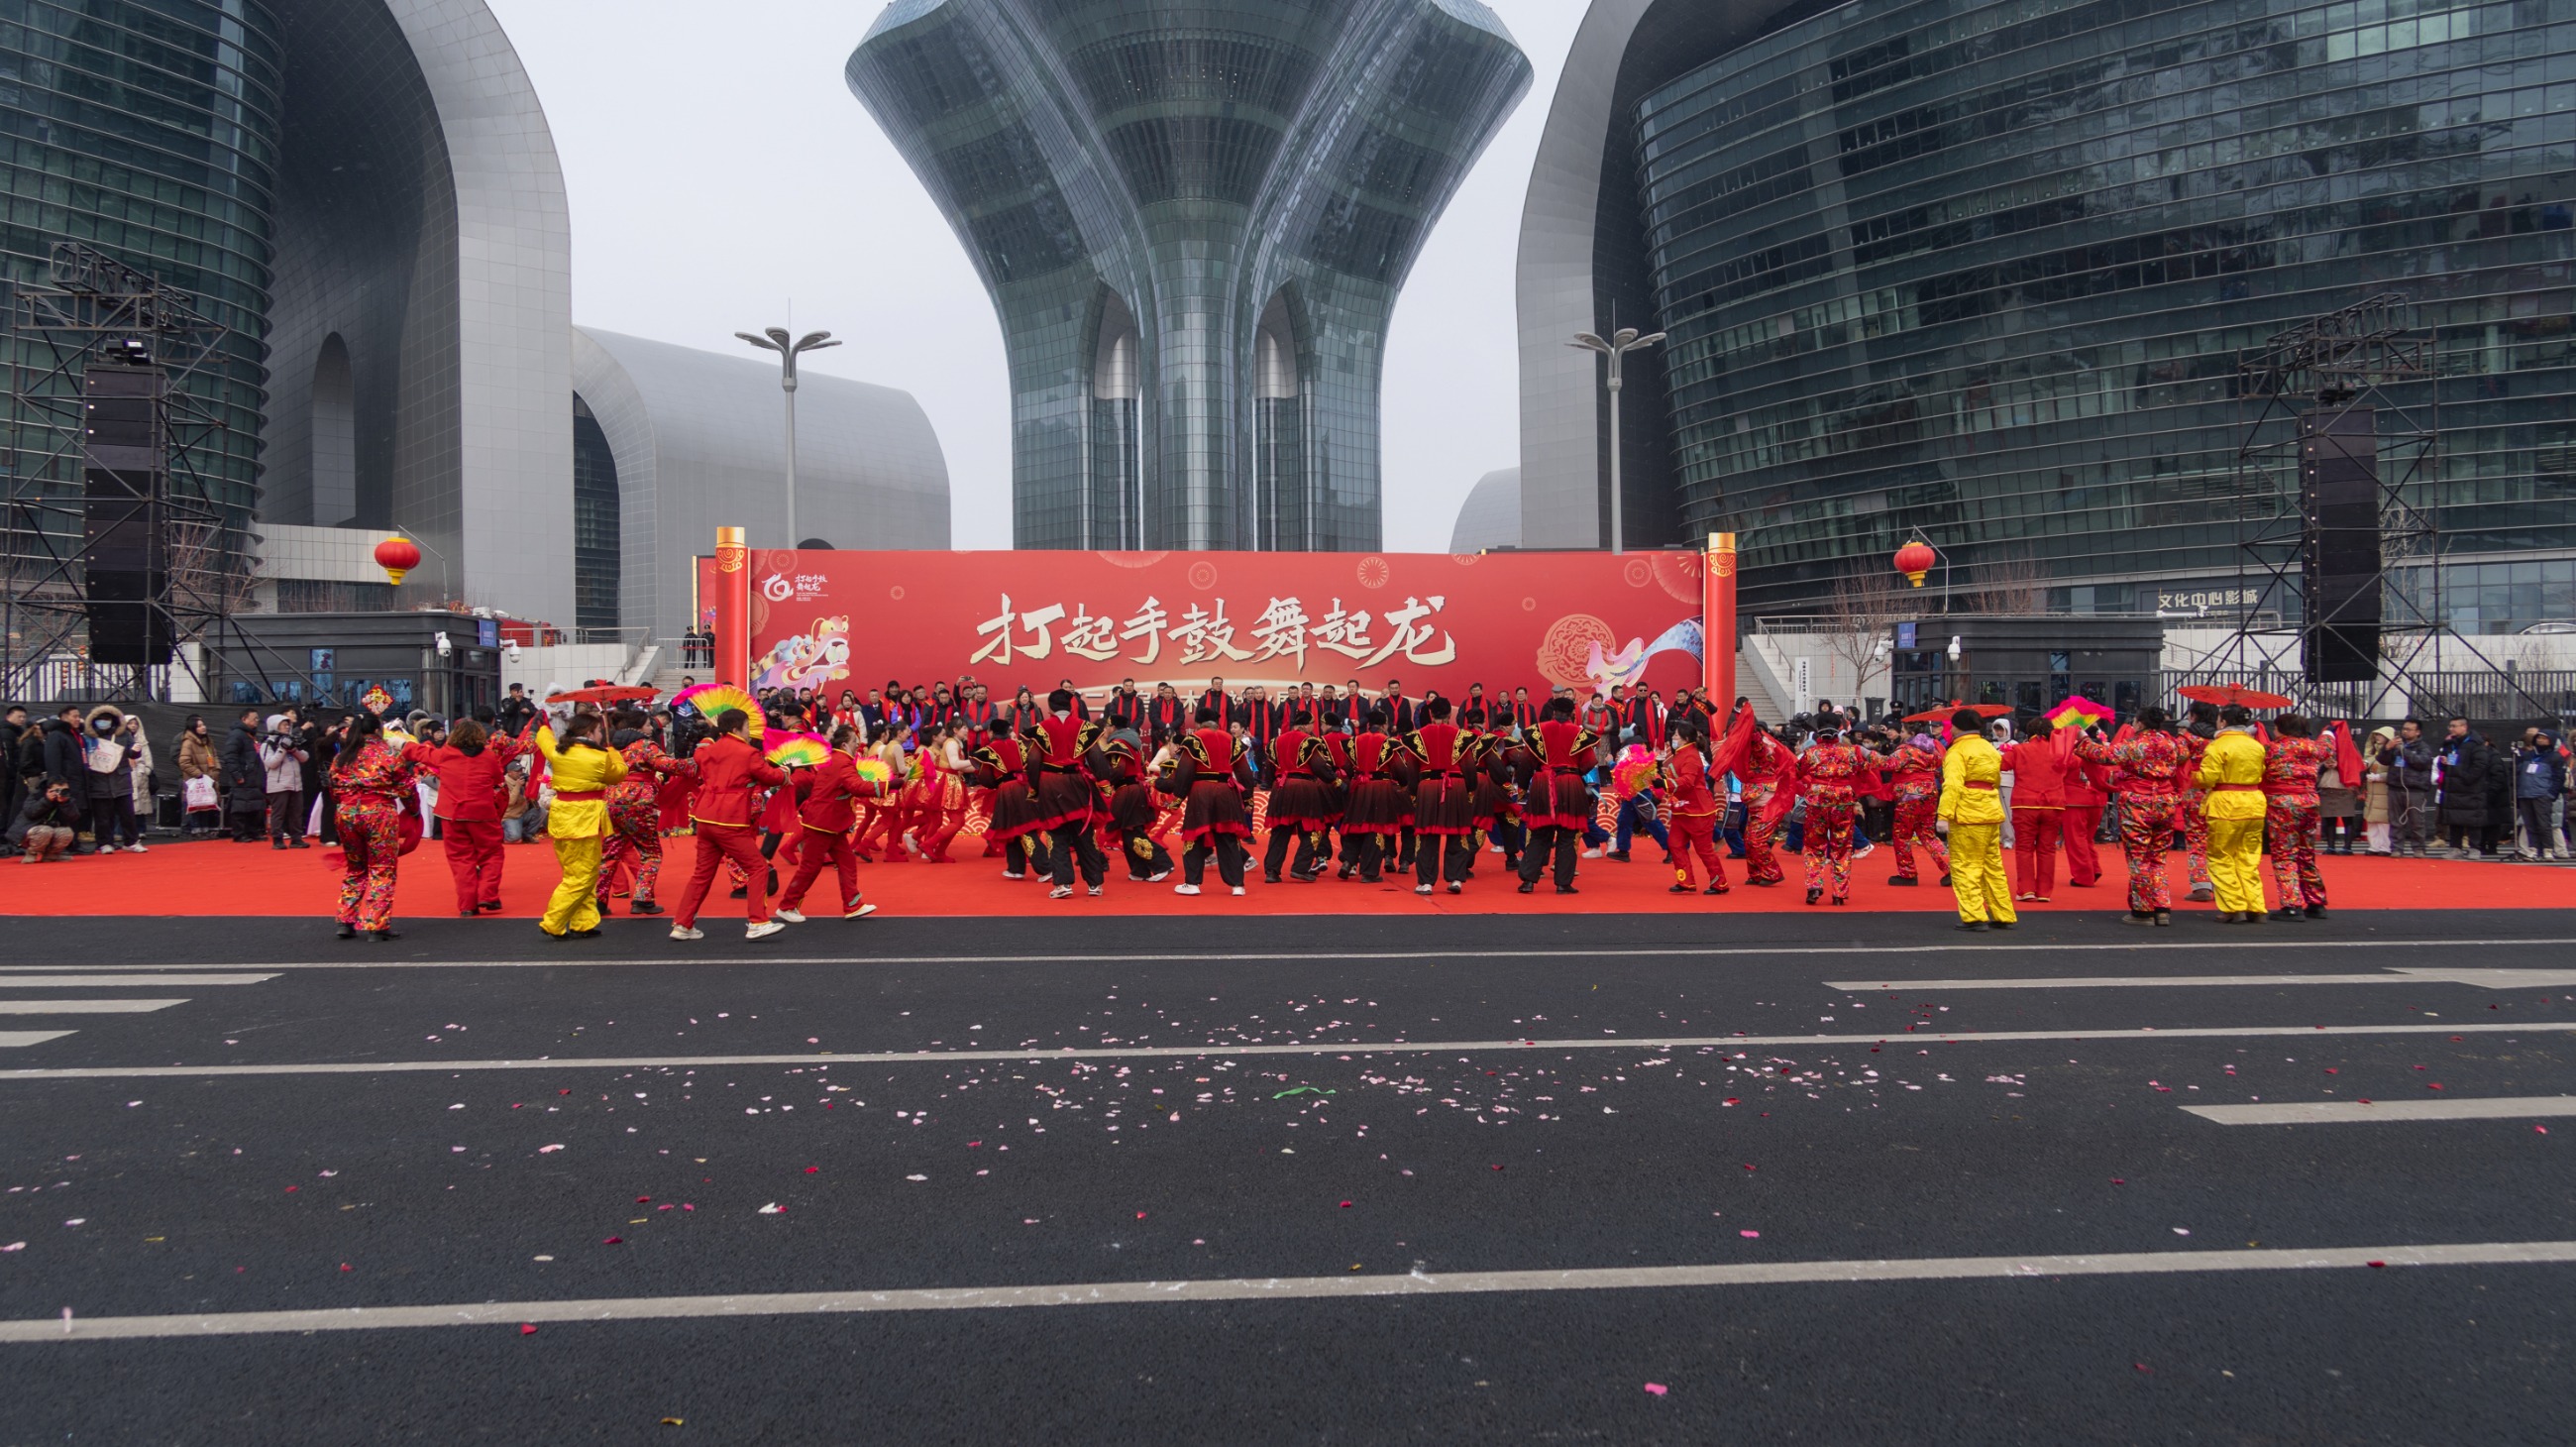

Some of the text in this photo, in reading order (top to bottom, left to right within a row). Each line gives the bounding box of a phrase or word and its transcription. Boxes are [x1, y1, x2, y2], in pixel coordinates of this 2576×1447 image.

[2158, 589, 2258, 609] 文化中心影城
[970, 593, 1456, 674] 打起手鼓舞起龙
